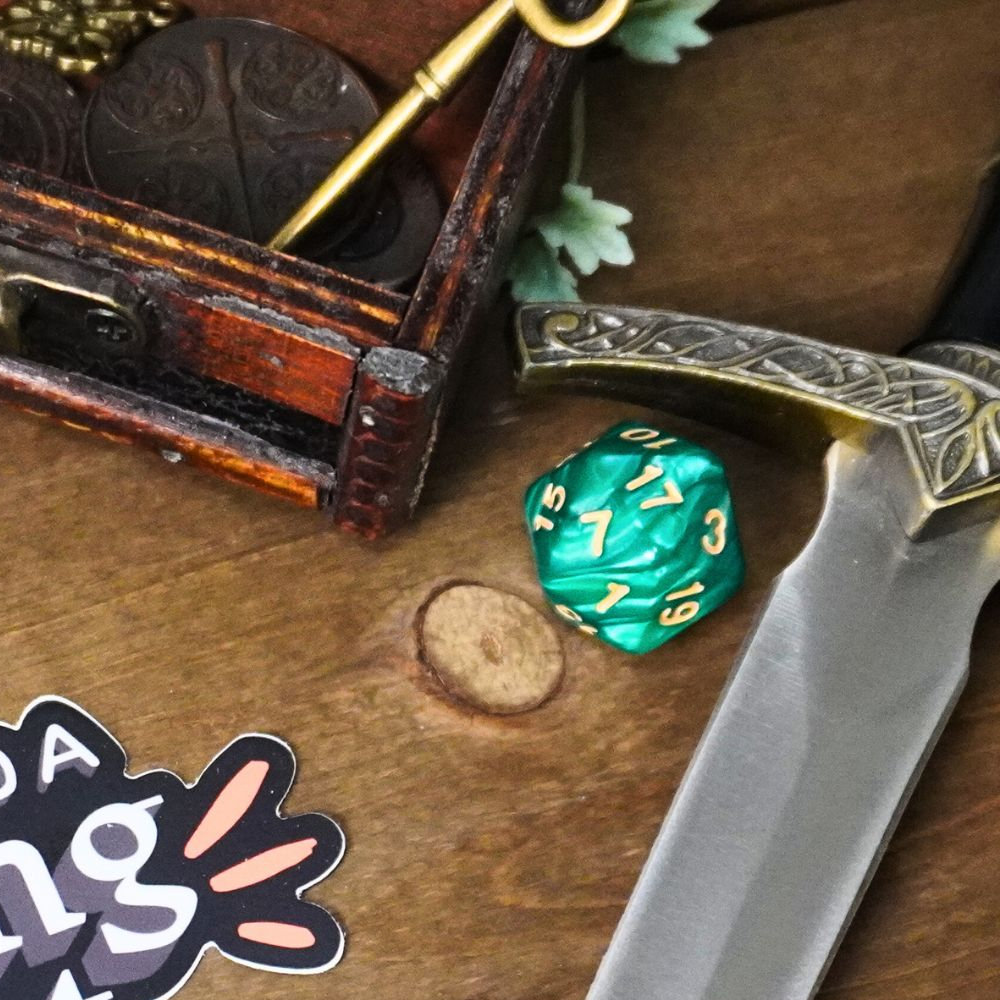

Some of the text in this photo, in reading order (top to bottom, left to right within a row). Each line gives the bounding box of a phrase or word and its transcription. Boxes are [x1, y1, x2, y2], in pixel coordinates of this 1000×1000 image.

[625, 463, 684, 510] 17
[579, 508, 614, 559] 7
[702, 507, 727, 556] 3
[40, 722, 101, 786] A
